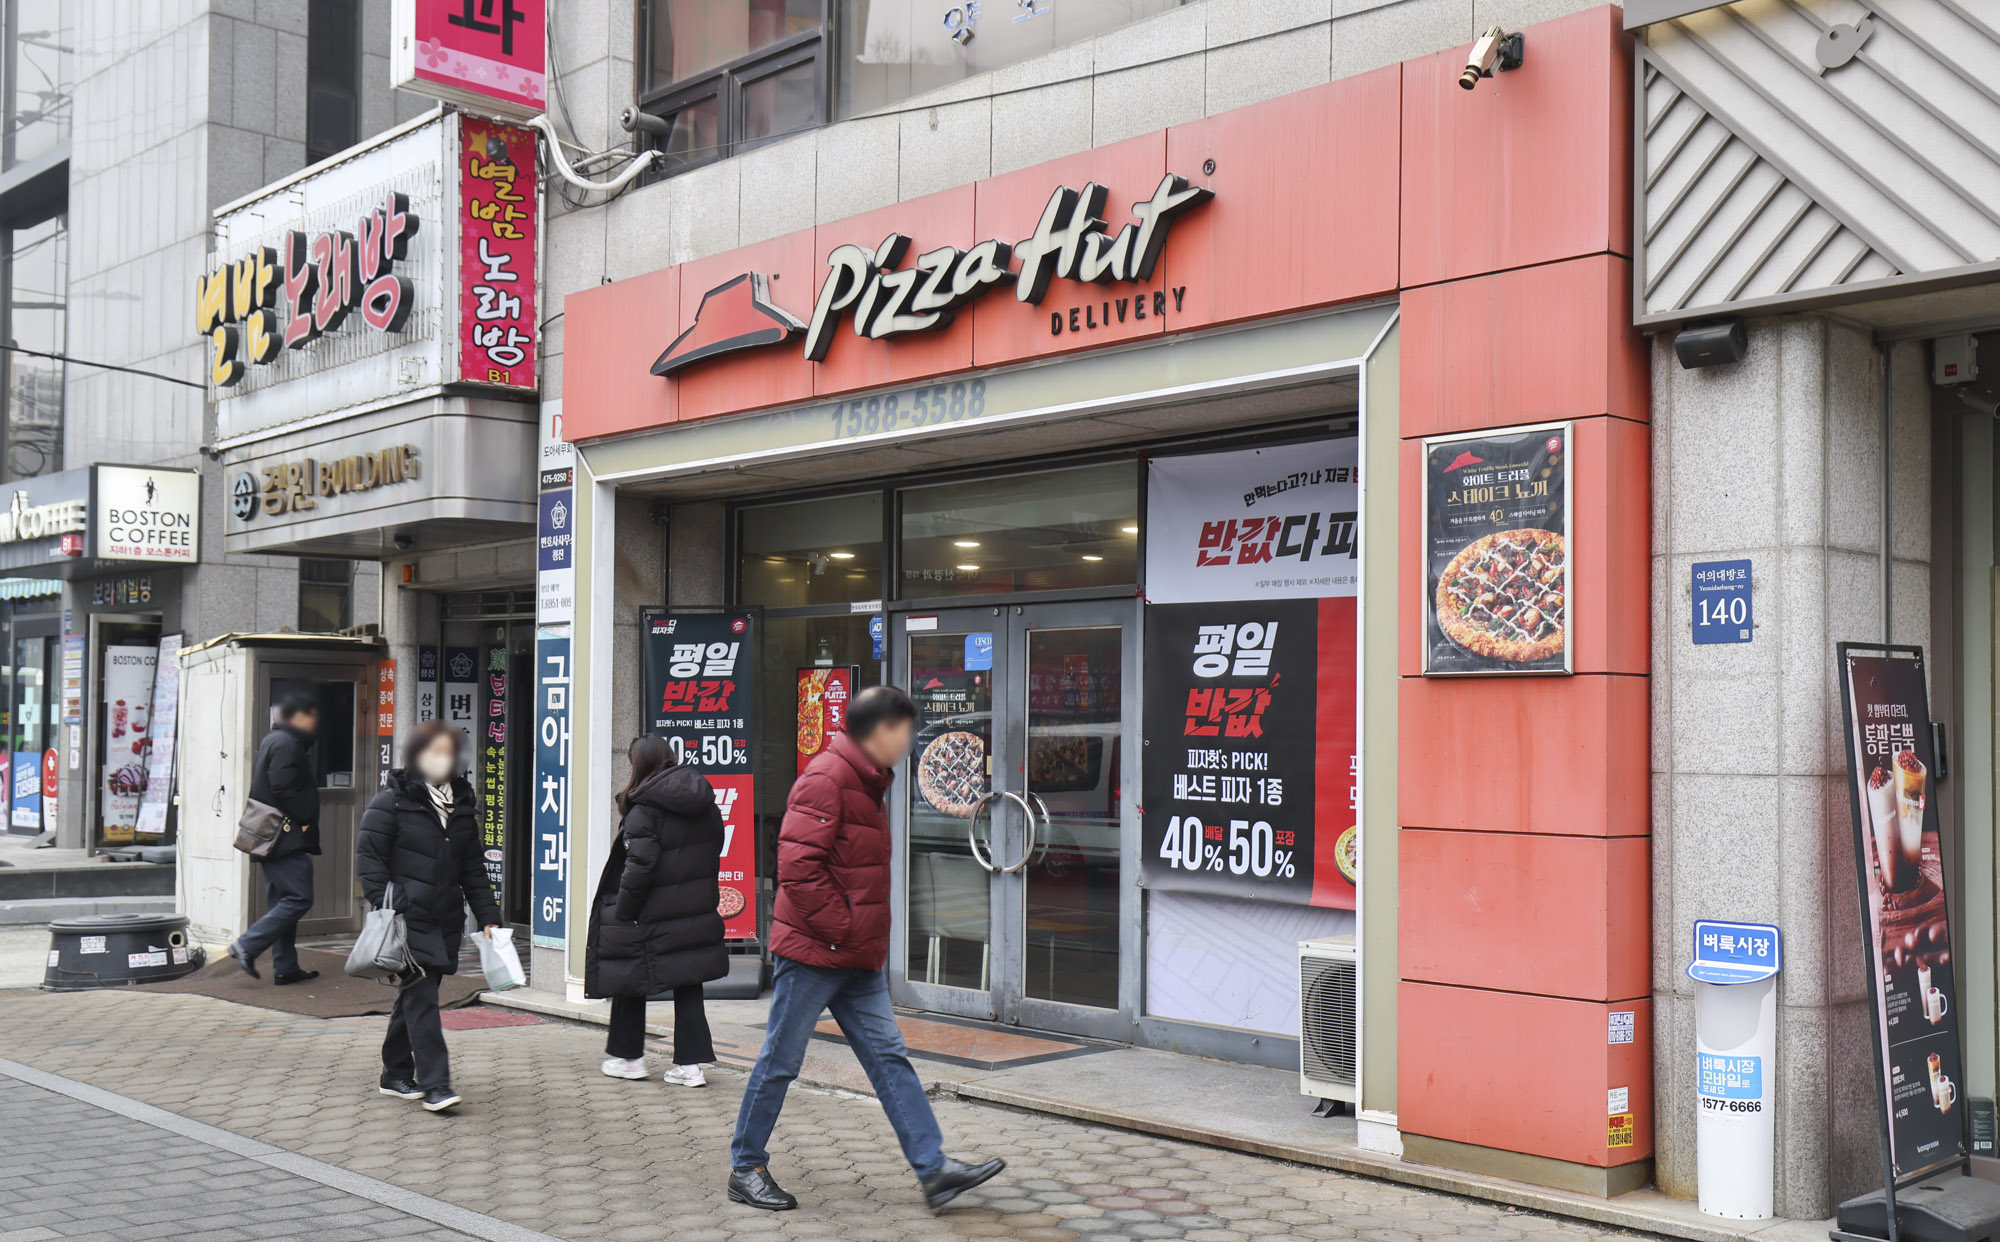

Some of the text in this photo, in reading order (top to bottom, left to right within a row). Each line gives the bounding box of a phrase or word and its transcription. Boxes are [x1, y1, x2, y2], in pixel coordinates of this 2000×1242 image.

[469, 157, 528, 240] 별밤
[804, 172, 1215, 363] Pizza Hut
[196, 190, 420, 388] 별밤 노래방
[471, 237, 532, 367] 노래방
[1051, 286, 1187, 336] DELIVERY
[488, 368, 511, 384] B1
[832, 379, 987, 440] 1588-5588
[261, 443, 419, 516] 경원 BUILDING
[1324, 467, 1350, 483] 지금
[1462, 468, 1531, 487] 화이트 트러플
[1447, 480, 1549, 507] 스테이크 뇨끼
[20, 499, 87, 539] COFFEE
[109, 509, 190, 528] BOSTON
[109, 527, 190, 546] COFFEE
[540, 533, 573, 549] 변호사사무
[1696, 568, 1747, 583] 여의대방로
[1698, 584, 1745, 592] Yeouidaebang-ro
[1699, 597, 1747, 626] 140
[975, 636, 992, 647] CESCO
[1192, 621, 1279, 678] 평일
[112, 655, 143, 666] BOSTON
[669, 642, 740, 678] 평일
[380, 667, 395, 682] 상속
[380, 690, 395, 705] 증여
[661, 680, 736, 713] 반값
[924, 702, 957, 713] 스테이크
[1184, 685, 1274, 738] 반값
[1867, 704, 1873, 718] 첫
[379, 713, 394, 728] 전문
[676, 719, 693, 728] PICK!
[694, 719, 715, 730] 베스트
[716, 718, 731, 729] 피자
[732, 718, 744, 729] 1종
[539, 655, 570, 881] 금아치과
[1231, 751, 1268, 771] PICK!
[1173, 773, 1283, 806] 베스트 피자 1종
[1204, 825, 1296, 846] 배달 포장
[542, 896, 563, 922] 6F
[1703, 932, 1770, 958] 벼룩시장
[1702, 1055, 1755, 1074] 벼룩시장
[1702, 1070, 1751, 1089] 모바일로
[1702, 1084, 1726, 1096] 보세요
[1702, 1097, 1762, 1113] 1577-6666
